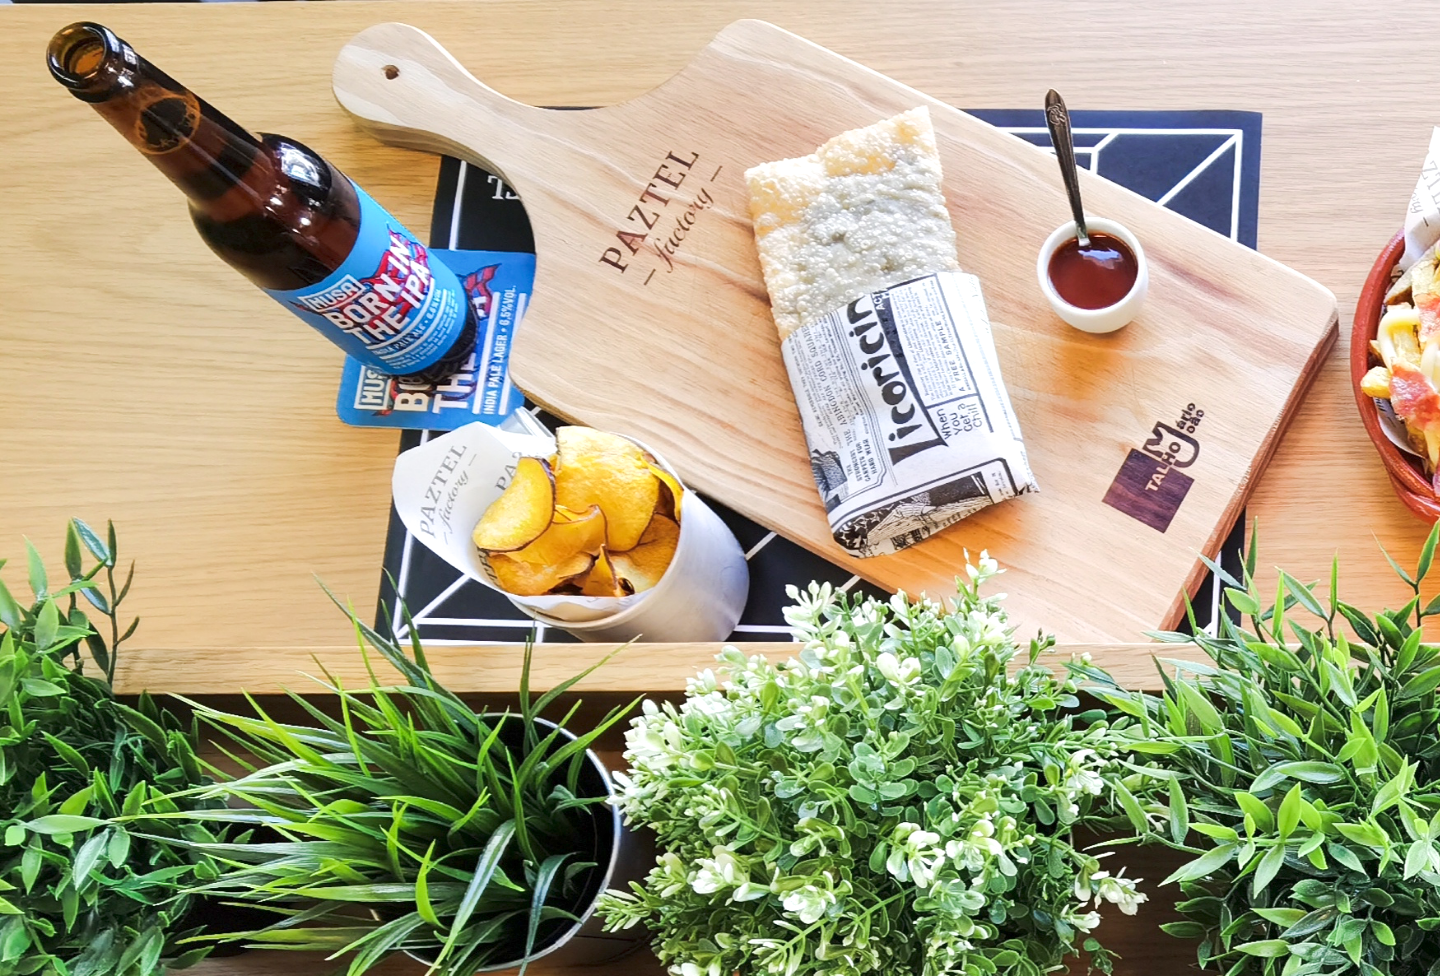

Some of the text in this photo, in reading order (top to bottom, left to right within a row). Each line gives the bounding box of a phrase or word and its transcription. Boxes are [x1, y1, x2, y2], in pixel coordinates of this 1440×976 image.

[599, 150, 700, 274] PAZTEL
[653, 187, 715, 274] factory
[323, 235, 413, 329] BORN IN
[343, 308, 411, 345] THE
[401, 261, 432, 309] IPA
[492, 333, 507, 363] LAGER
[935, 320, 952, 355] SAMPLE
[488, 364, 502, 387] PALE
[813, 359, 828, 382] CORD
[949, 359, 960, 381] FREE
[483, 386, 496, 415] INDIA
[821, 383, 847, 427] ABINGDON
[966, 402, 983, 428] Chill
[934, 407, 953, 439] When
[947, 411, 964, 435] You
[958, 412, 973, 432] Get
[861, 438, 872, 455] WEAR
[1145, 441, 1181, 492] TALHO
[419, 445, 468, 538] PAZTEL
[438, 470, 469, 534] factory
